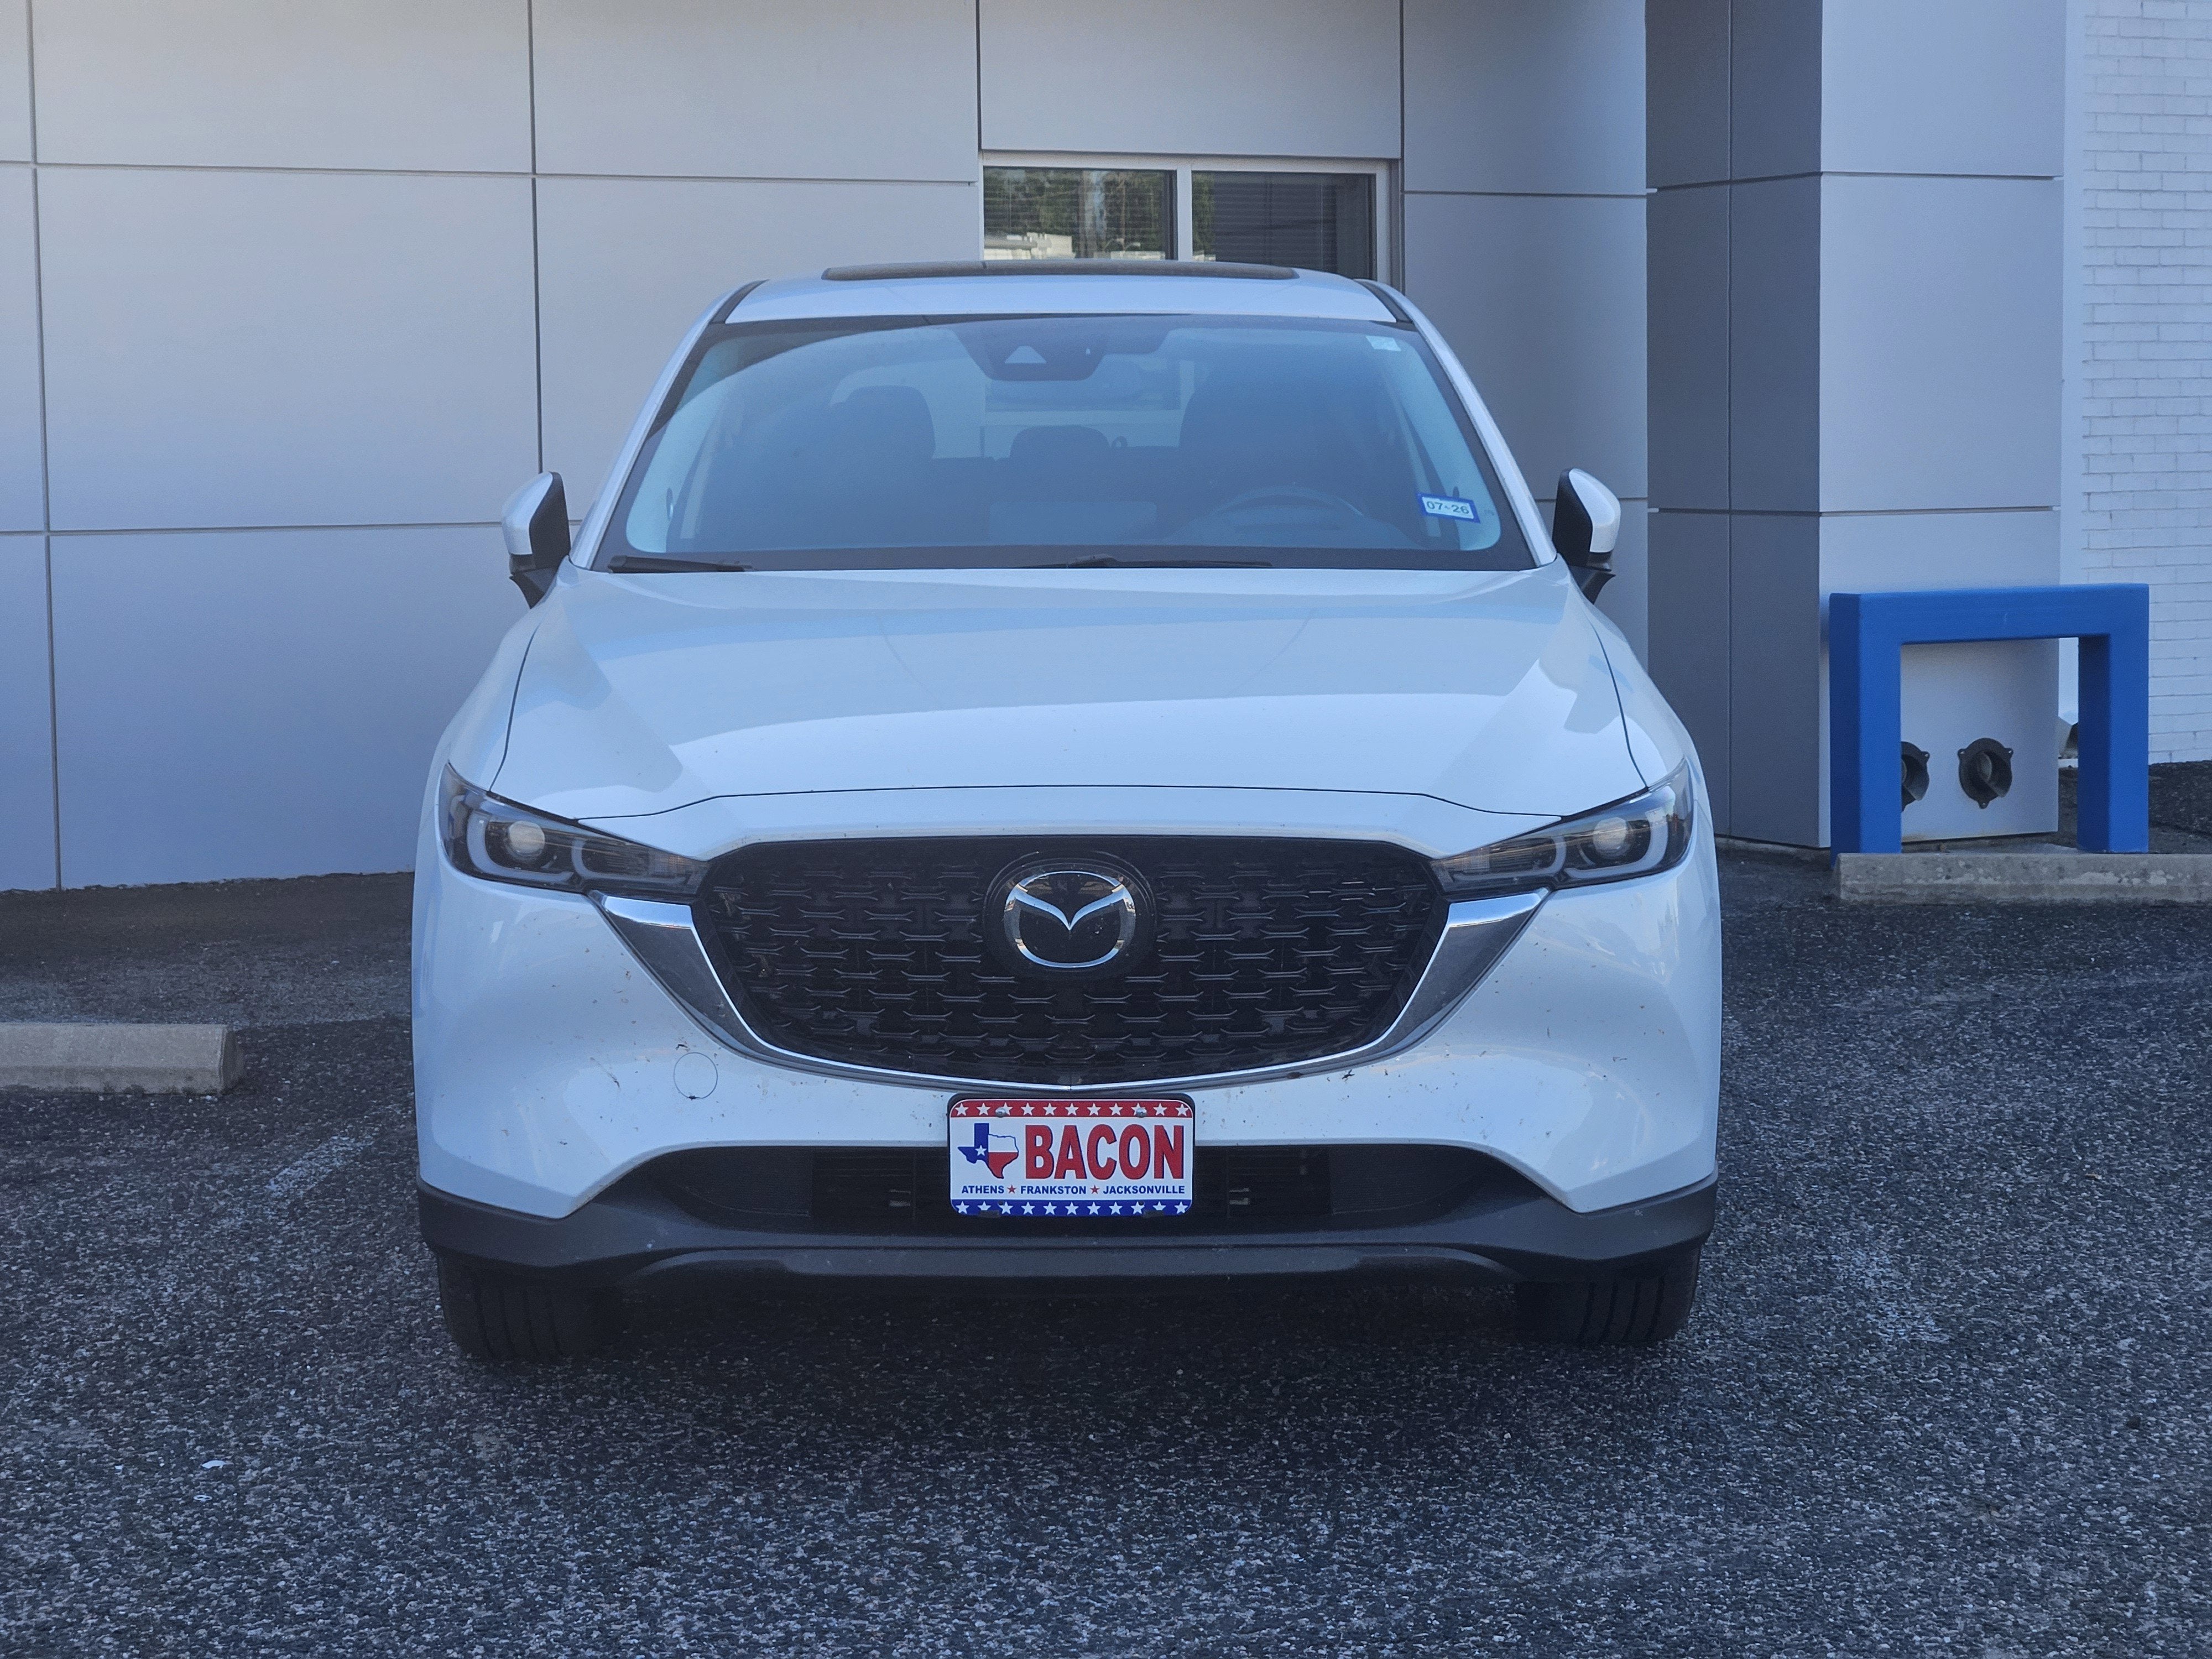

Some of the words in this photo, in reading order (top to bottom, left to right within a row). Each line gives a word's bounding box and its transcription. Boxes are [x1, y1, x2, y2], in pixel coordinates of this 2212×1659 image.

[1426, 501, 1469, 514] 07-26
[1025, 1124, 1185, 1180] BACON
[961, 1186, 1005, 1194] ATHENS
[1020, 1186, 1086, 1195] FRANKSTON
[1103, 1186, 1185, 1195] JACKSONVILLE
